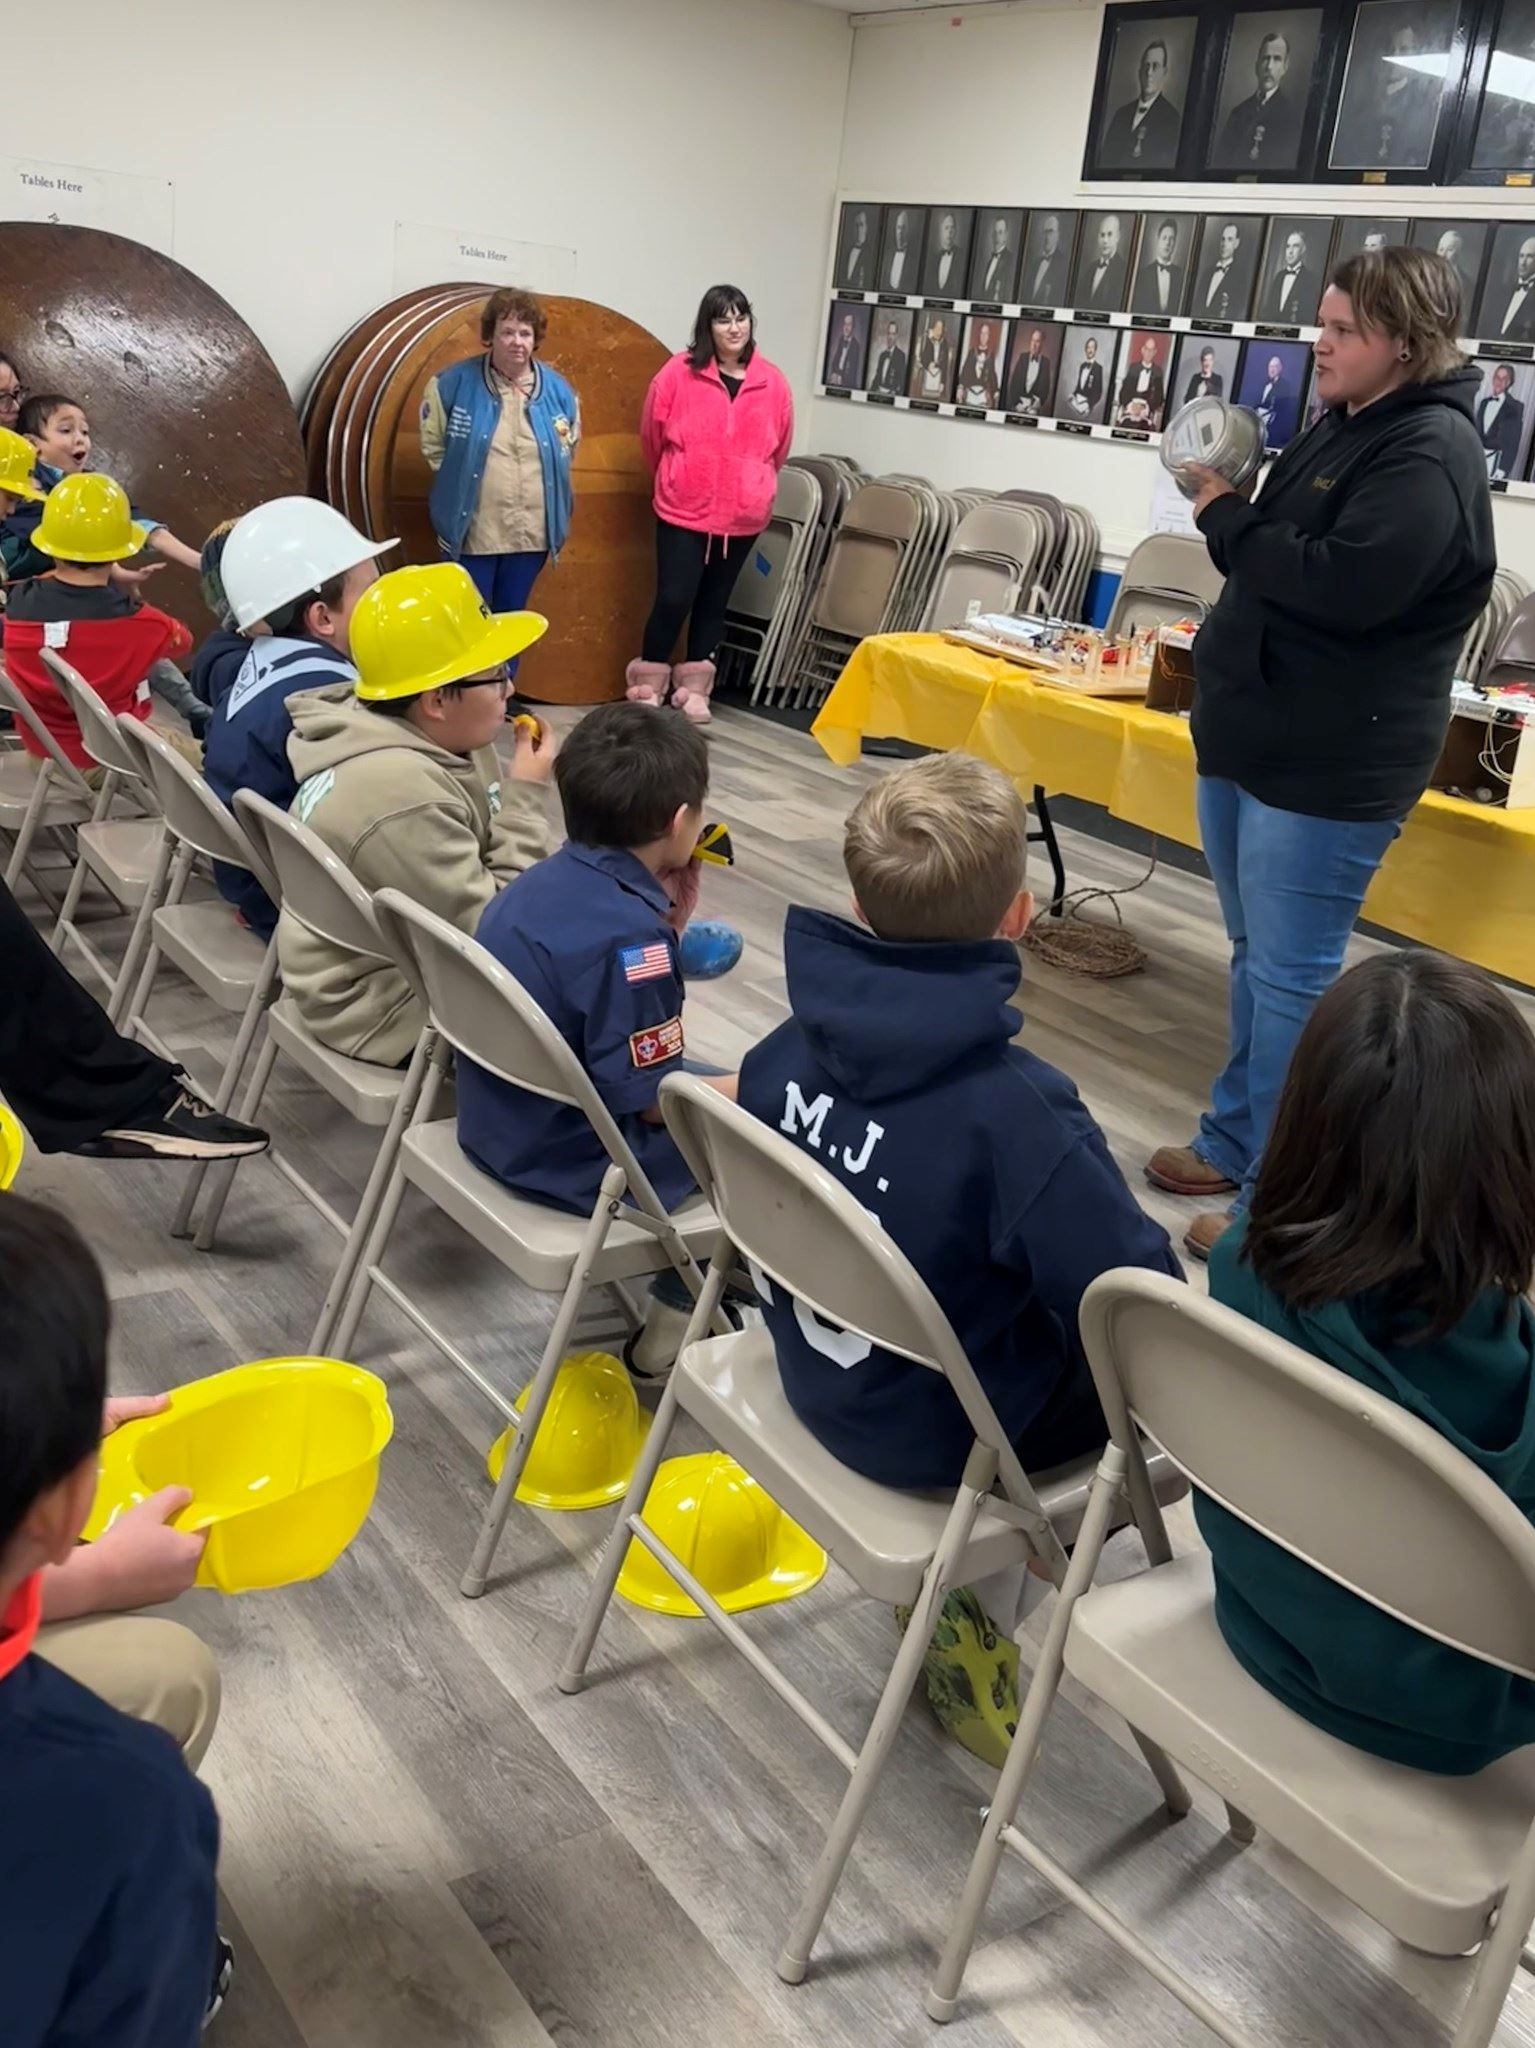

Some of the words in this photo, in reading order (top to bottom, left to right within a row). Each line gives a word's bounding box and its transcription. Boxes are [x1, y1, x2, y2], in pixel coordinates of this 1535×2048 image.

[21, 174, 54, 188] Tables
[58, 179, 83, 192] Here
[460, 246, 485, 258] Tables
[488, 251, 507, 261] Here
[780, 1080, 889, 1192] M.J.
